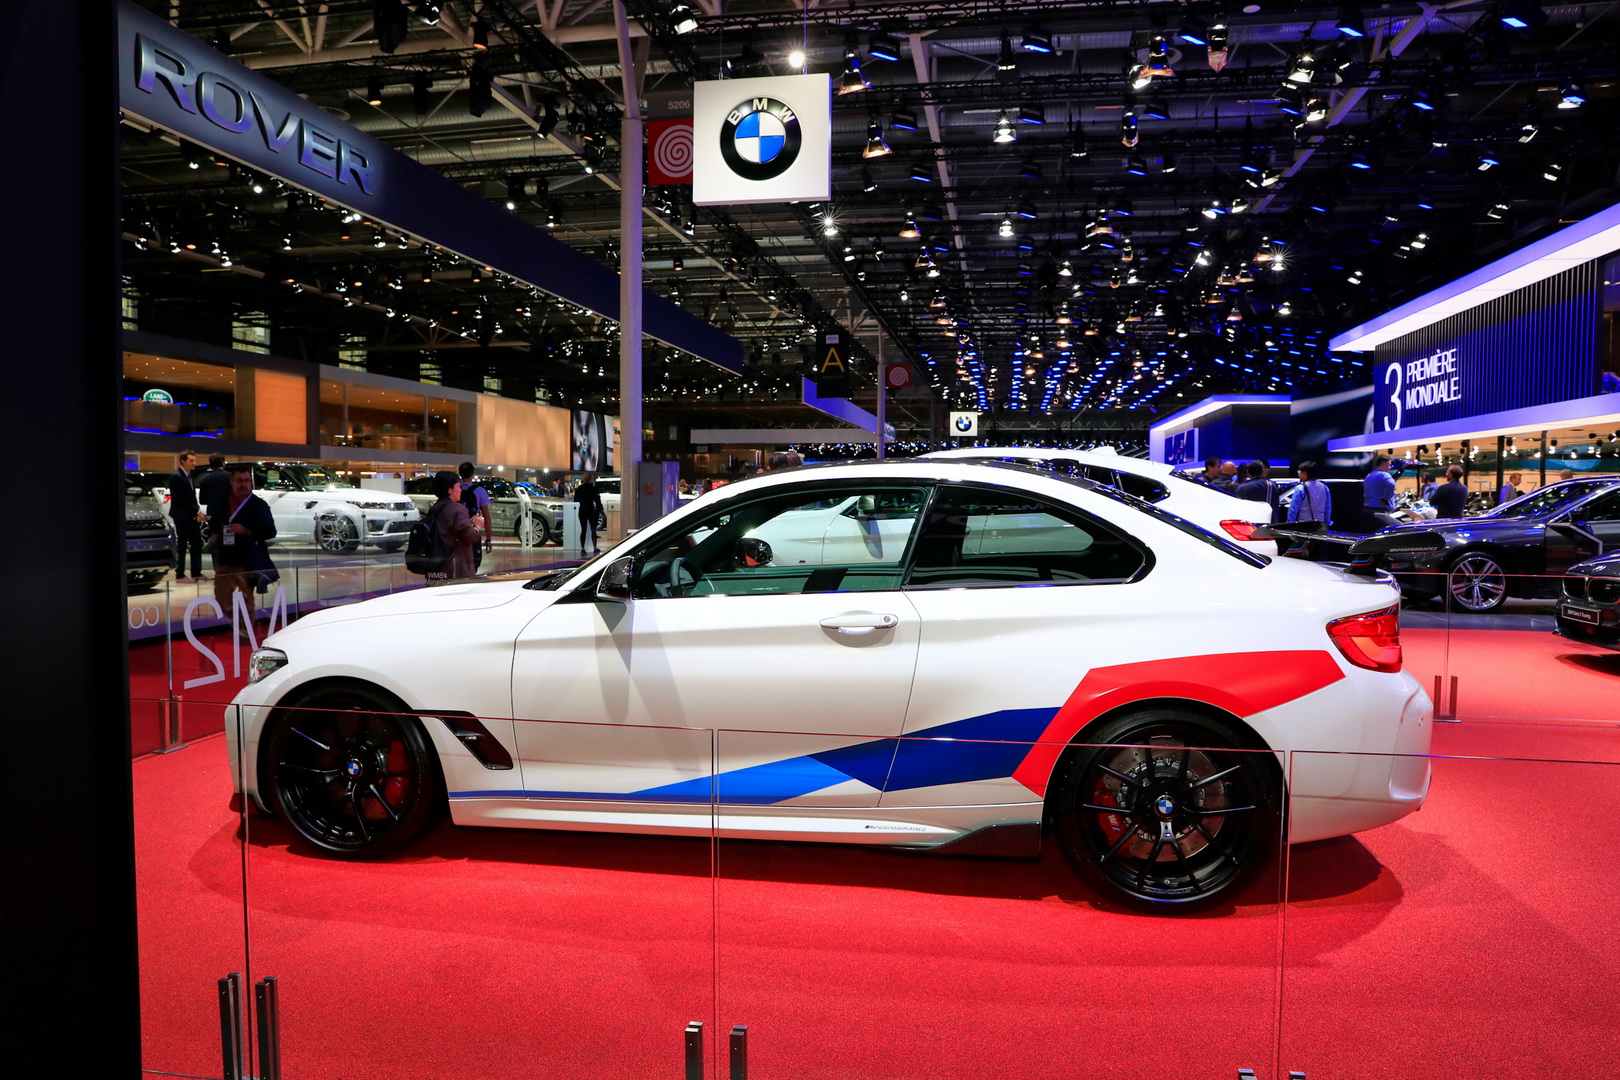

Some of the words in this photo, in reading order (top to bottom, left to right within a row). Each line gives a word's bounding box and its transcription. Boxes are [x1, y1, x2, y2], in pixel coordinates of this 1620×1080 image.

[134, 32, 374, 197] ROVER
[668, 100, 691, 110] 5206
[727, 98, 796, 126] BMW
[821, 347, 845, 373] A
[1384, 362, 1402, 432] 3
[1406, 348, 1457, 384] PREMIÈRE
